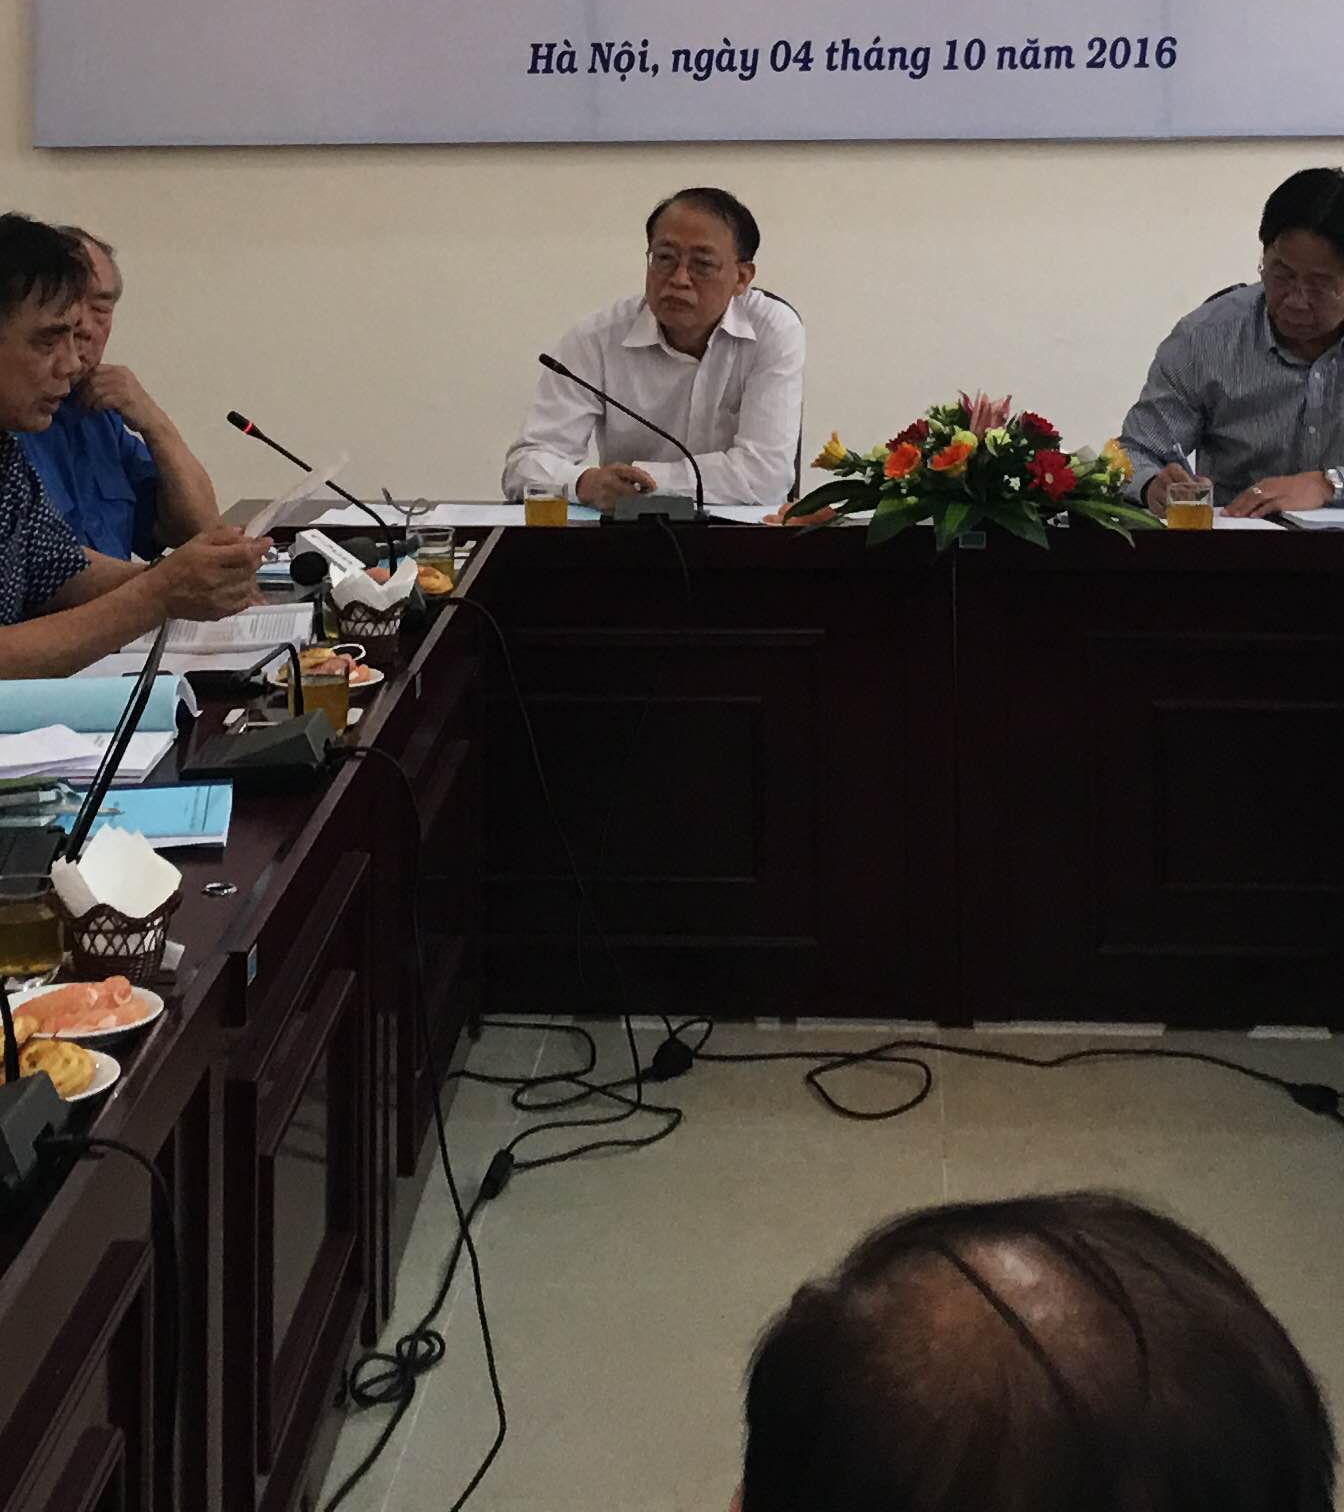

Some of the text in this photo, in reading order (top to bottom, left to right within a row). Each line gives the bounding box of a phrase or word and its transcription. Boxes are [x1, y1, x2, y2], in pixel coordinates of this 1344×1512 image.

[527, 36, 1177, 82] Hà Nội, ngày 04 tháng 10 năm 2016
